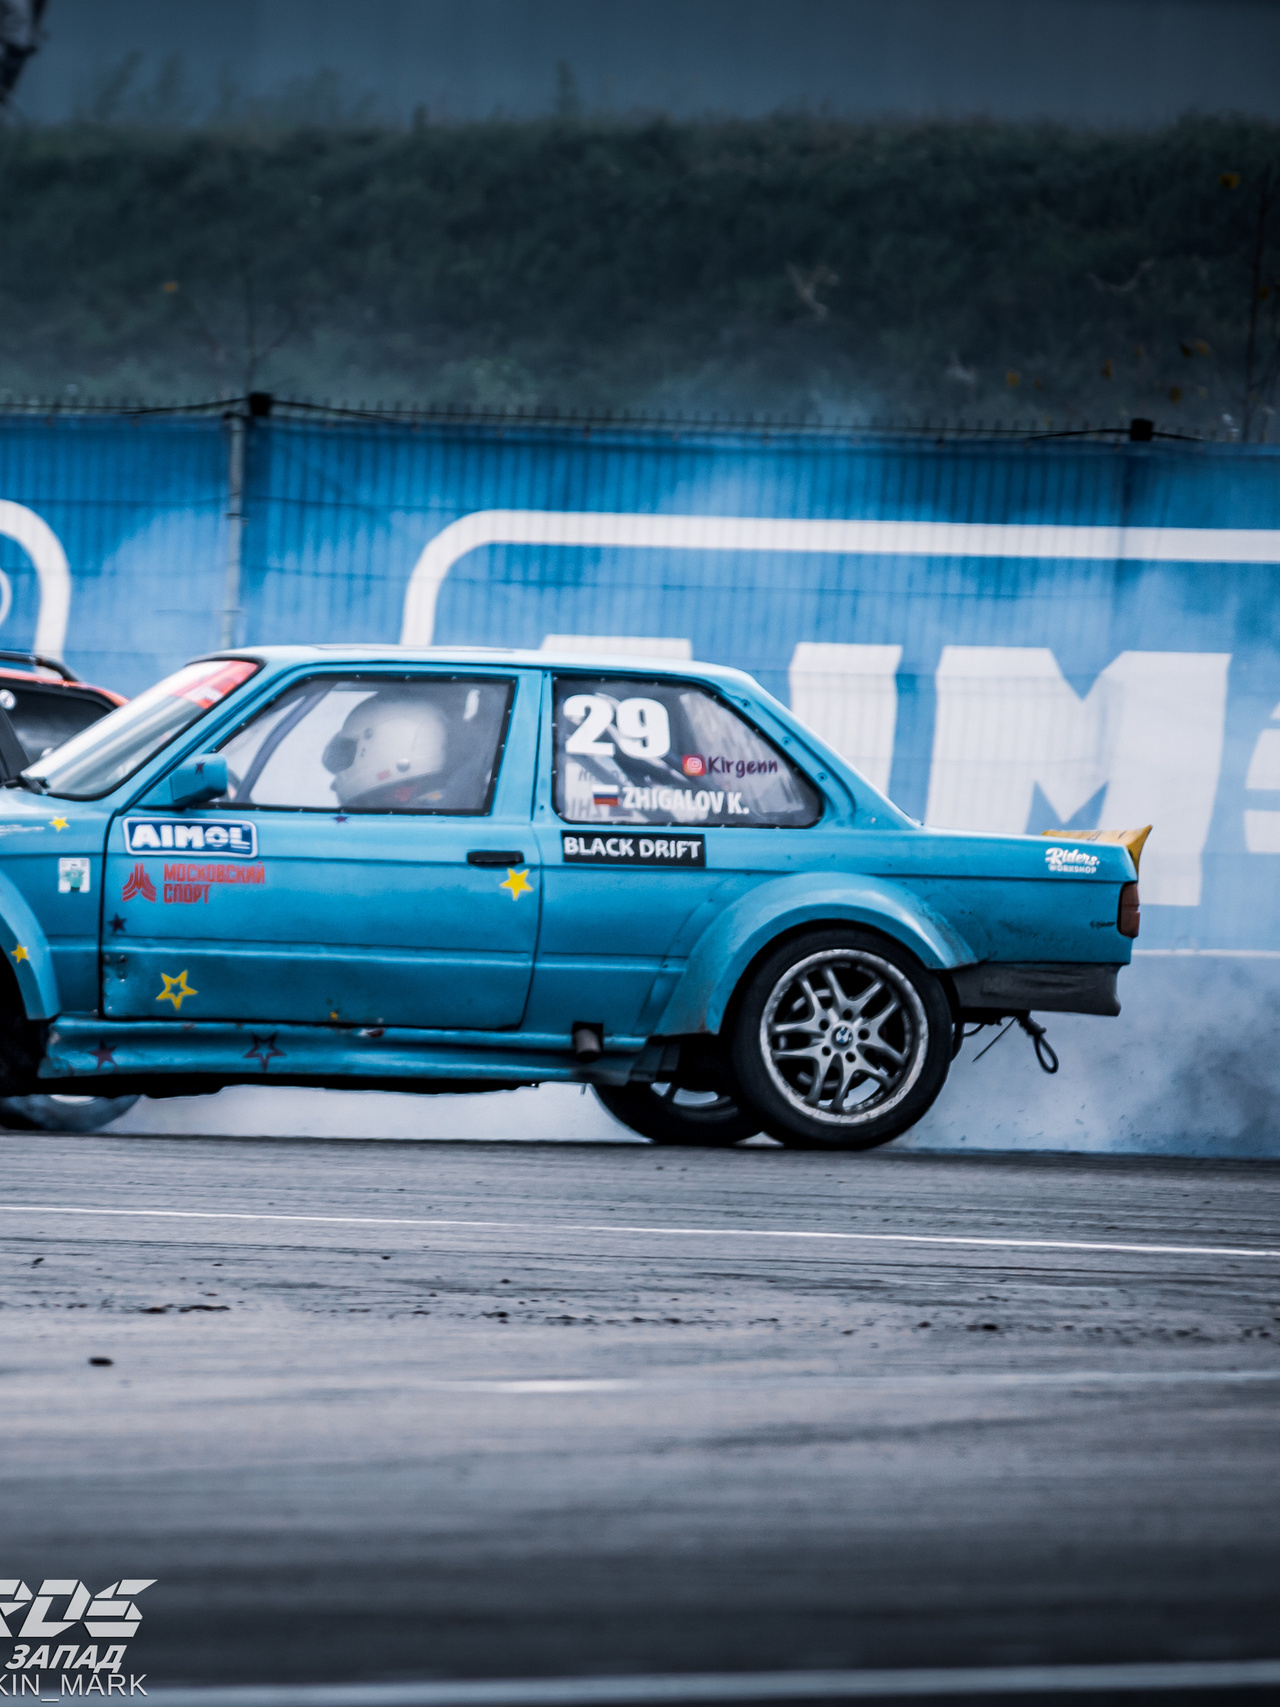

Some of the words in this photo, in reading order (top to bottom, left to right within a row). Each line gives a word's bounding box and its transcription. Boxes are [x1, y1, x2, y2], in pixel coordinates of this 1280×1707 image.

[563, 694, 671, 759] 29
[708, 755, 779, 778] Kirgenn
[622, 786, 724, 814] ZHIGALOV
[727, 792, 750, 815] K.
[131, 823, 251, 850] AIMOL
[564, 837, 634, 857] BLACK
[639, 839, 702, 859] DRIFT
[163, 861, 265, 884] МОСКОВСКИЙ
[163, 884, 211, 904] СПОРТ
